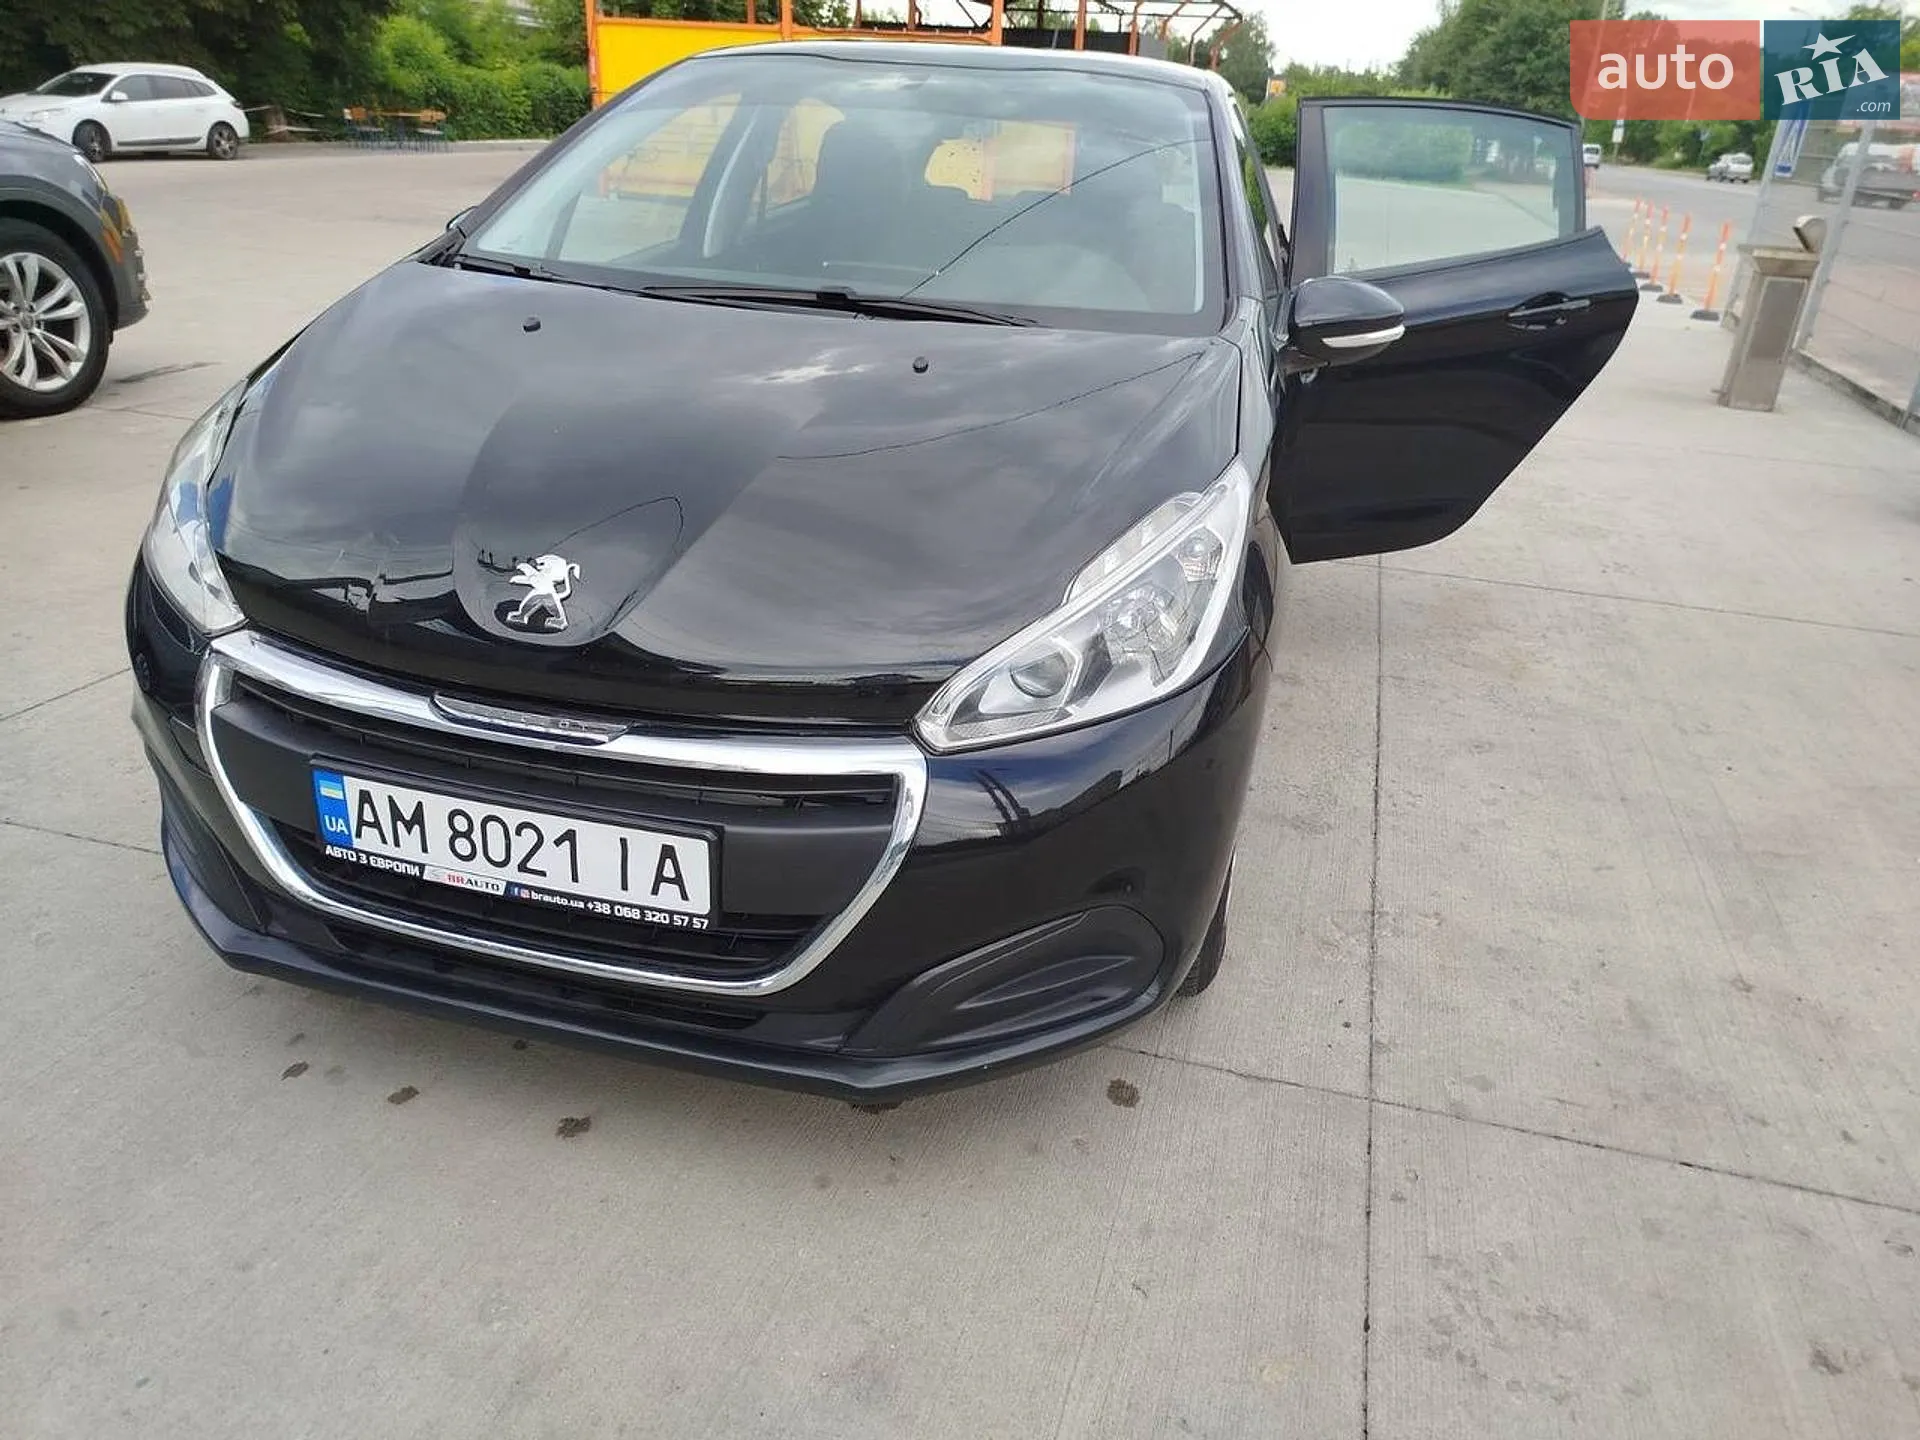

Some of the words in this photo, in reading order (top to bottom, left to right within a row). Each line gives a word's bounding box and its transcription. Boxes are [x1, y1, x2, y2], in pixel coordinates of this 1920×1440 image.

[325, 815, 349, 835] UA
[325, 845, 357, 862] АВТО
[369, 856, 420, 877] ЄВРОПИ
[355, 789, 429, 854] AM
[448, 808, 579, 884] 8021
[619, 837, 690, 901] IA
[530, 890, 585, 909] brauto.ua
[586, 901, 611, 915] +38
[614, 905, 641, 920] 068
[644, 910, 670, 924] 320
[673, 914, 690, 927] 57
[692, 918, 709, 930] 57
